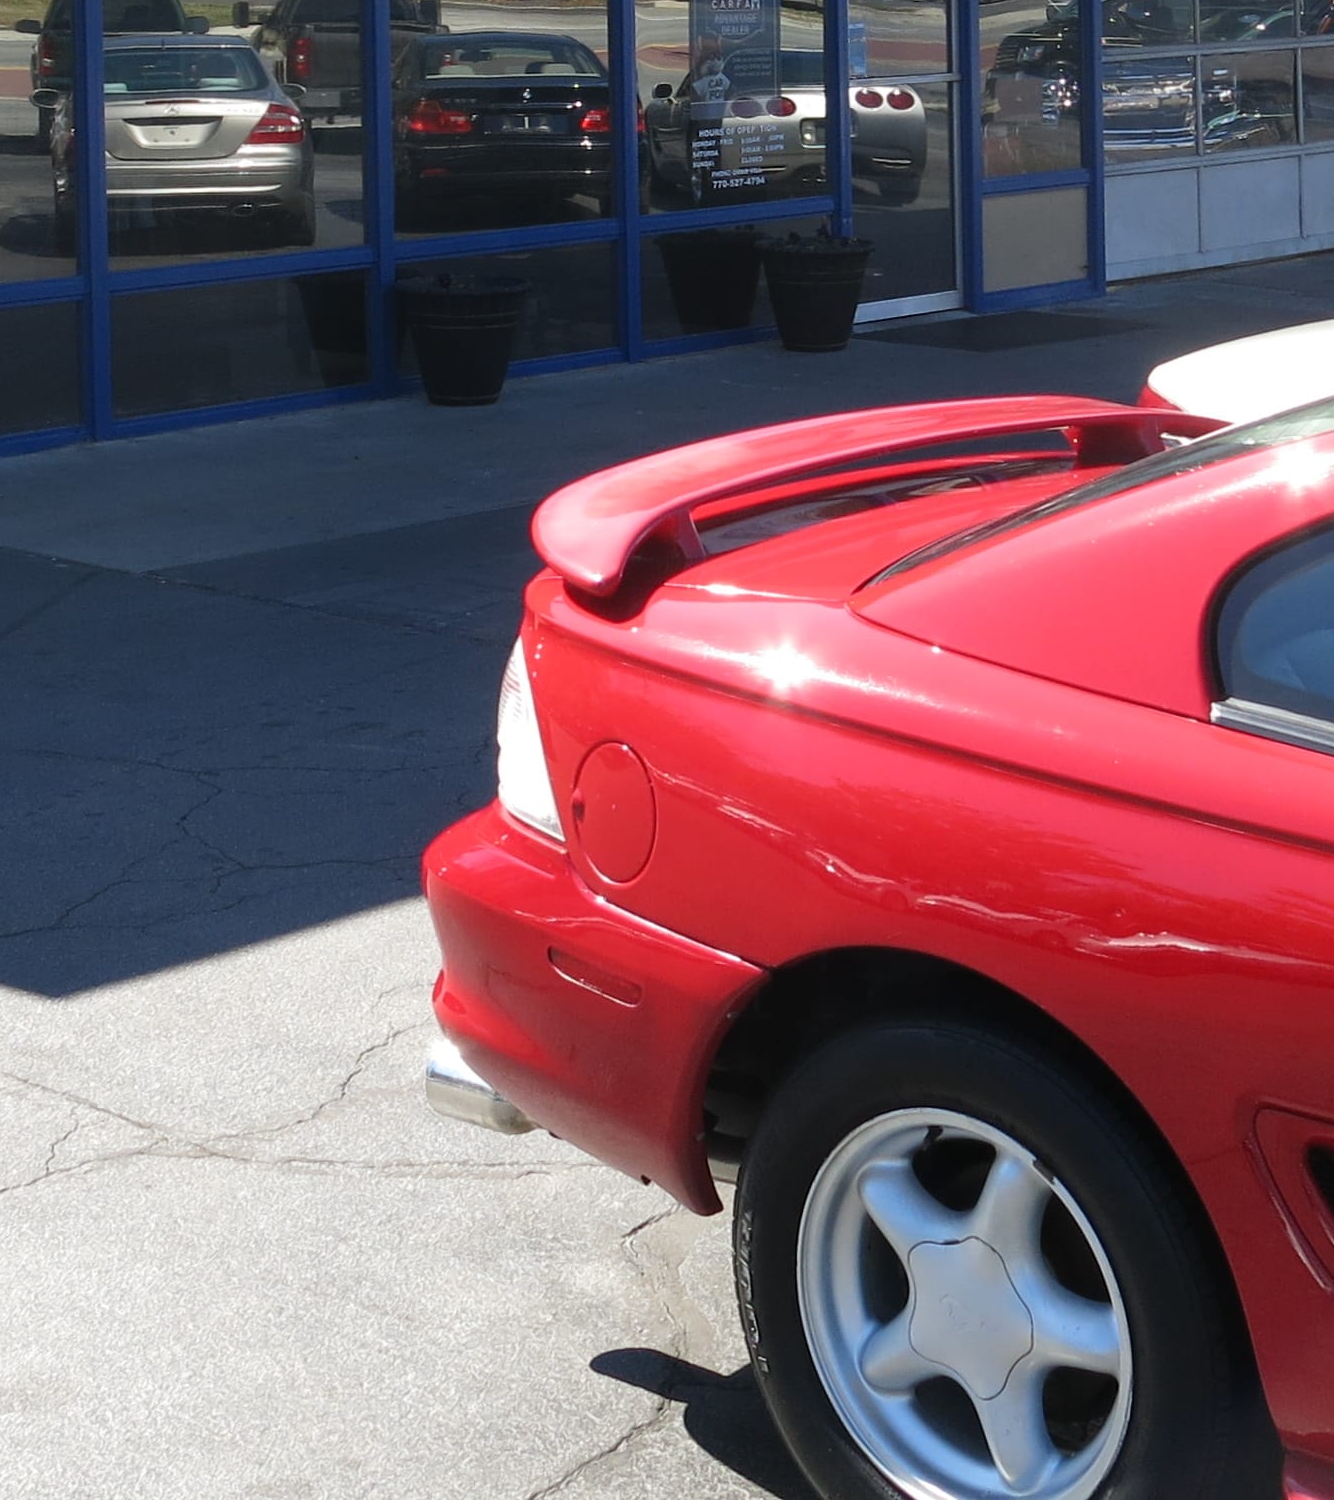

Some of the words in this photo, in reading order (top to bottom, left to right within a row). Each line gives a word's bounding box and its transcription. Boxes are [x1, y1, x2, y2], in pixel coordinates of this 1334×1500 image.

[699, 128, 725, 137] HOURS
[726, 127, 735, 135] OF
[737, 124, 778, 134] OPERTION
